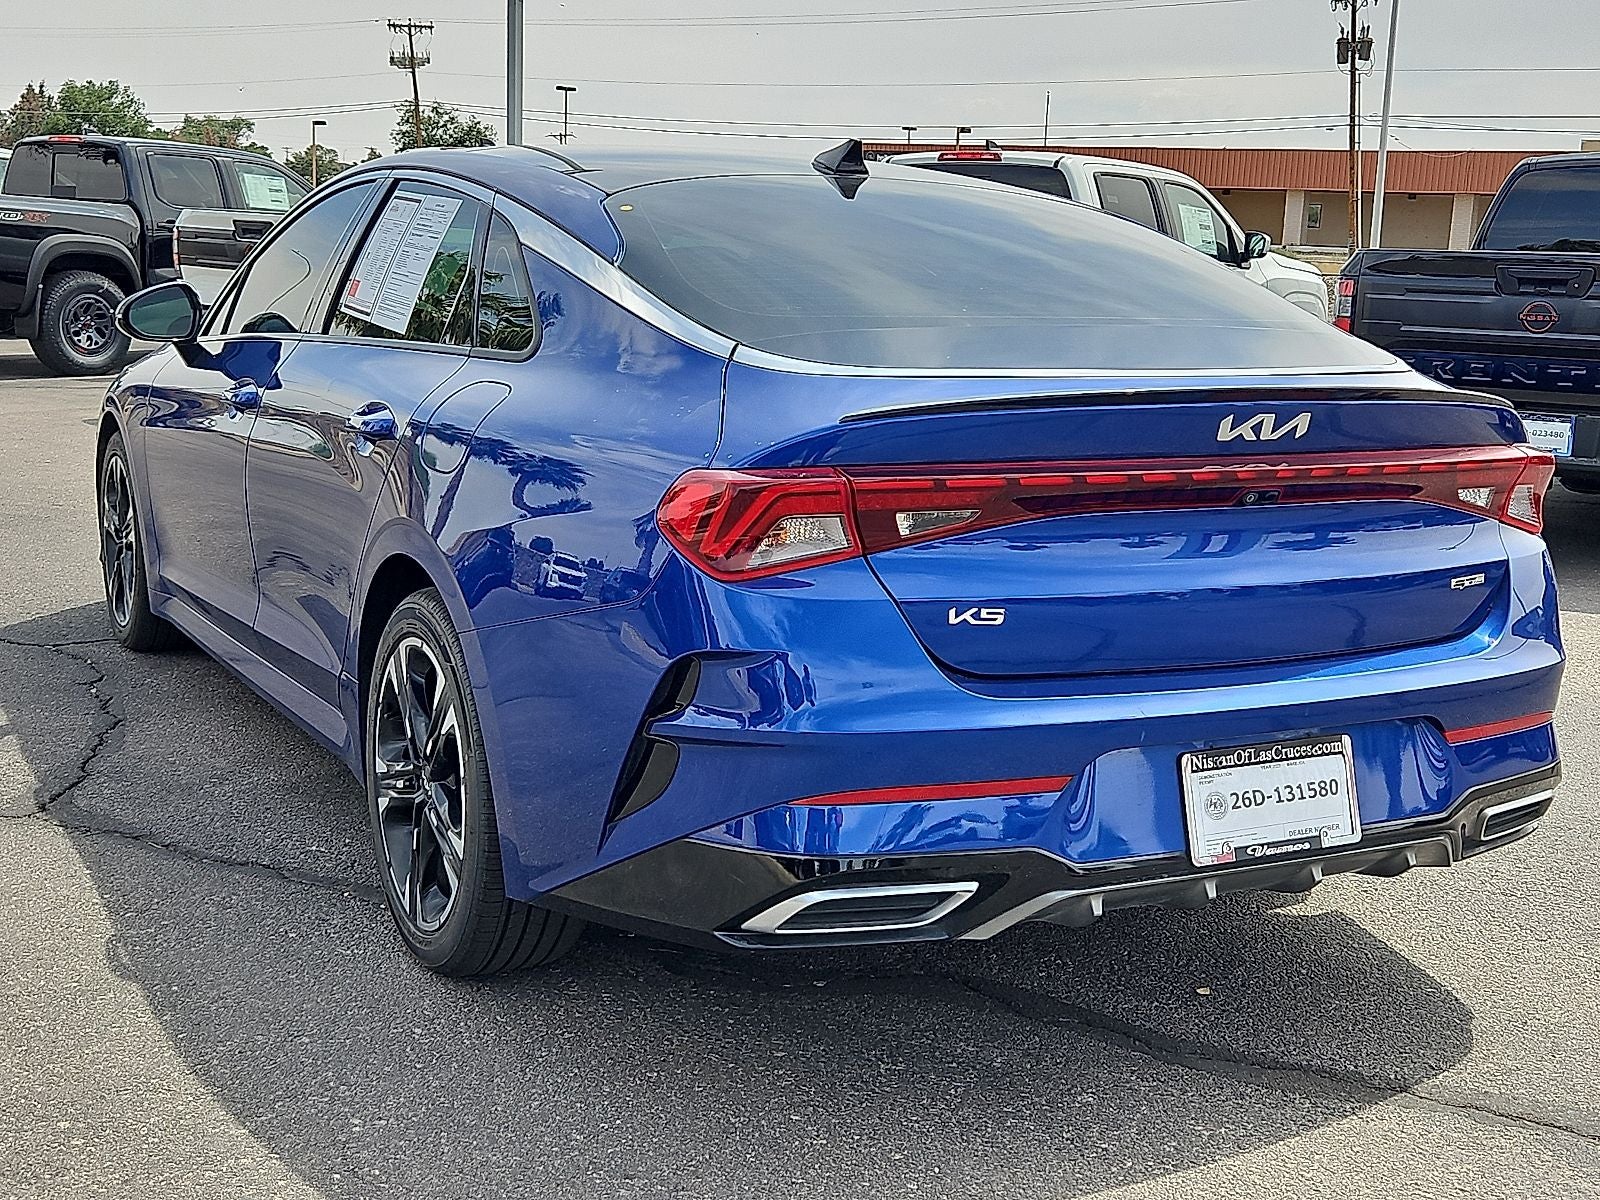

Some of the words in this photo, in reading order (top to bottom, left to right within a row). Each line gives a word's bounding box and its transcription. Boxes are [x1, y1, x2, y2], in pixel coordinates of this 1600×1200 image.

[1519, 313, 1559, 322] NISSAN
[1401, 355, 1600, 388] RONT
[948, 606, 1006, 626] K5
[1229, 778, 1339, 811] 26D-131580
[1288, 827, 1313, 838] DEALER
